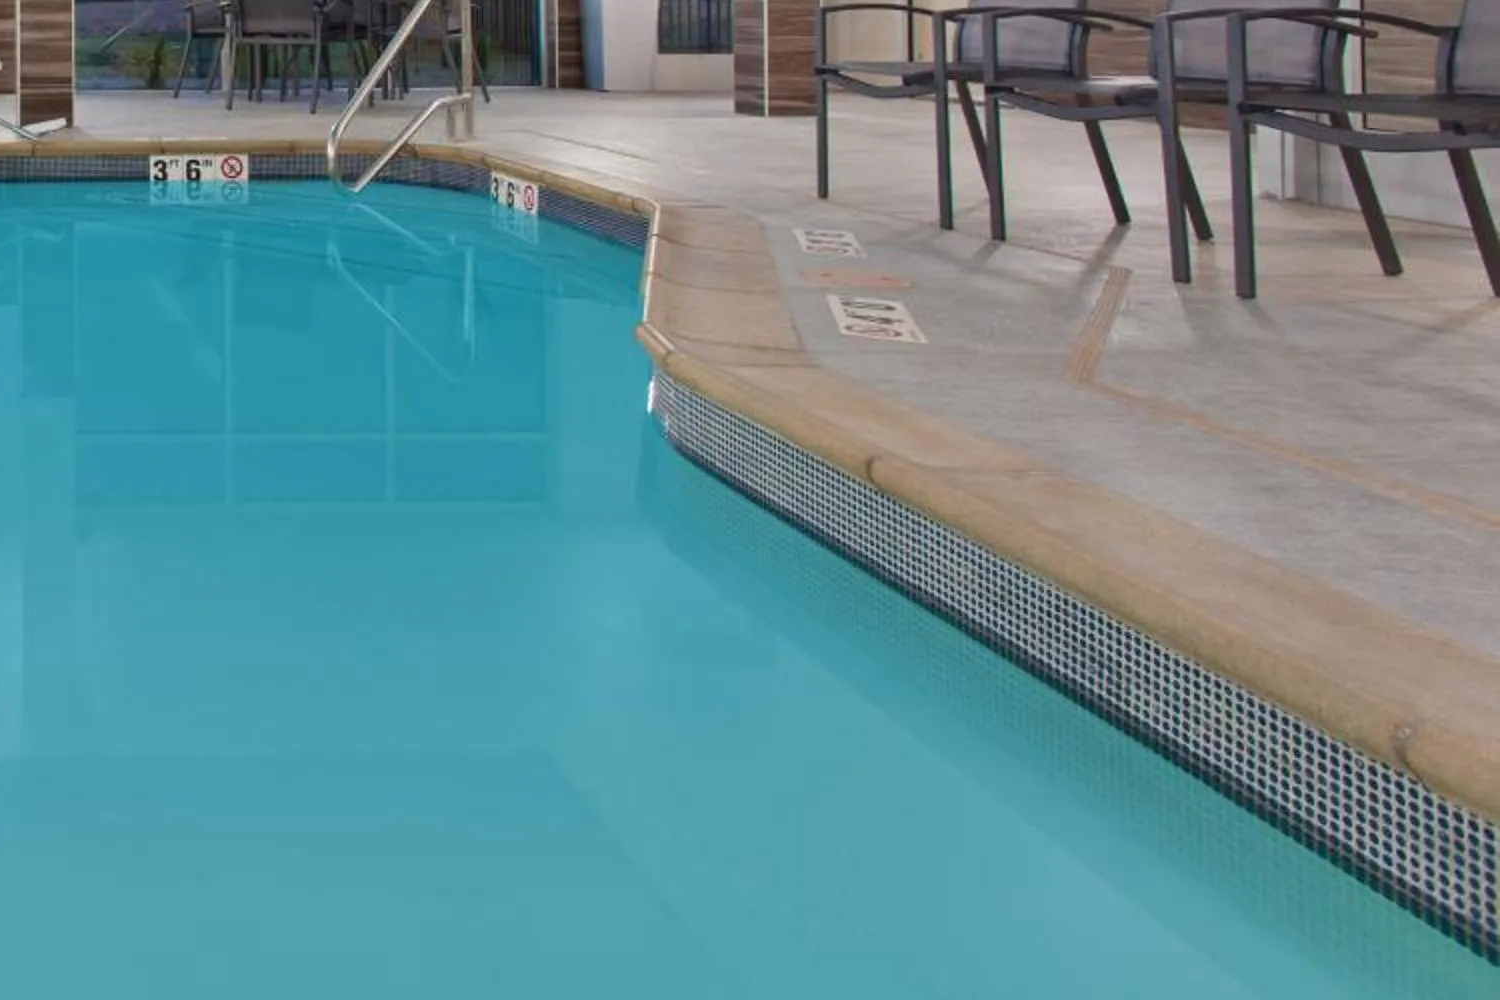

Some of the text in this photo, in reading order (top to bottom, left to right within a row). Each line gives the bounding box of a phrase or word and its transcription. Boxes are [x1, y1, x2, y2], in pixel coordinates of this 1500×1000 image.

[153, 159, 168, 181] 3
[186, 159, 200, 181] 6
[507, 181, 514, 208] 6
